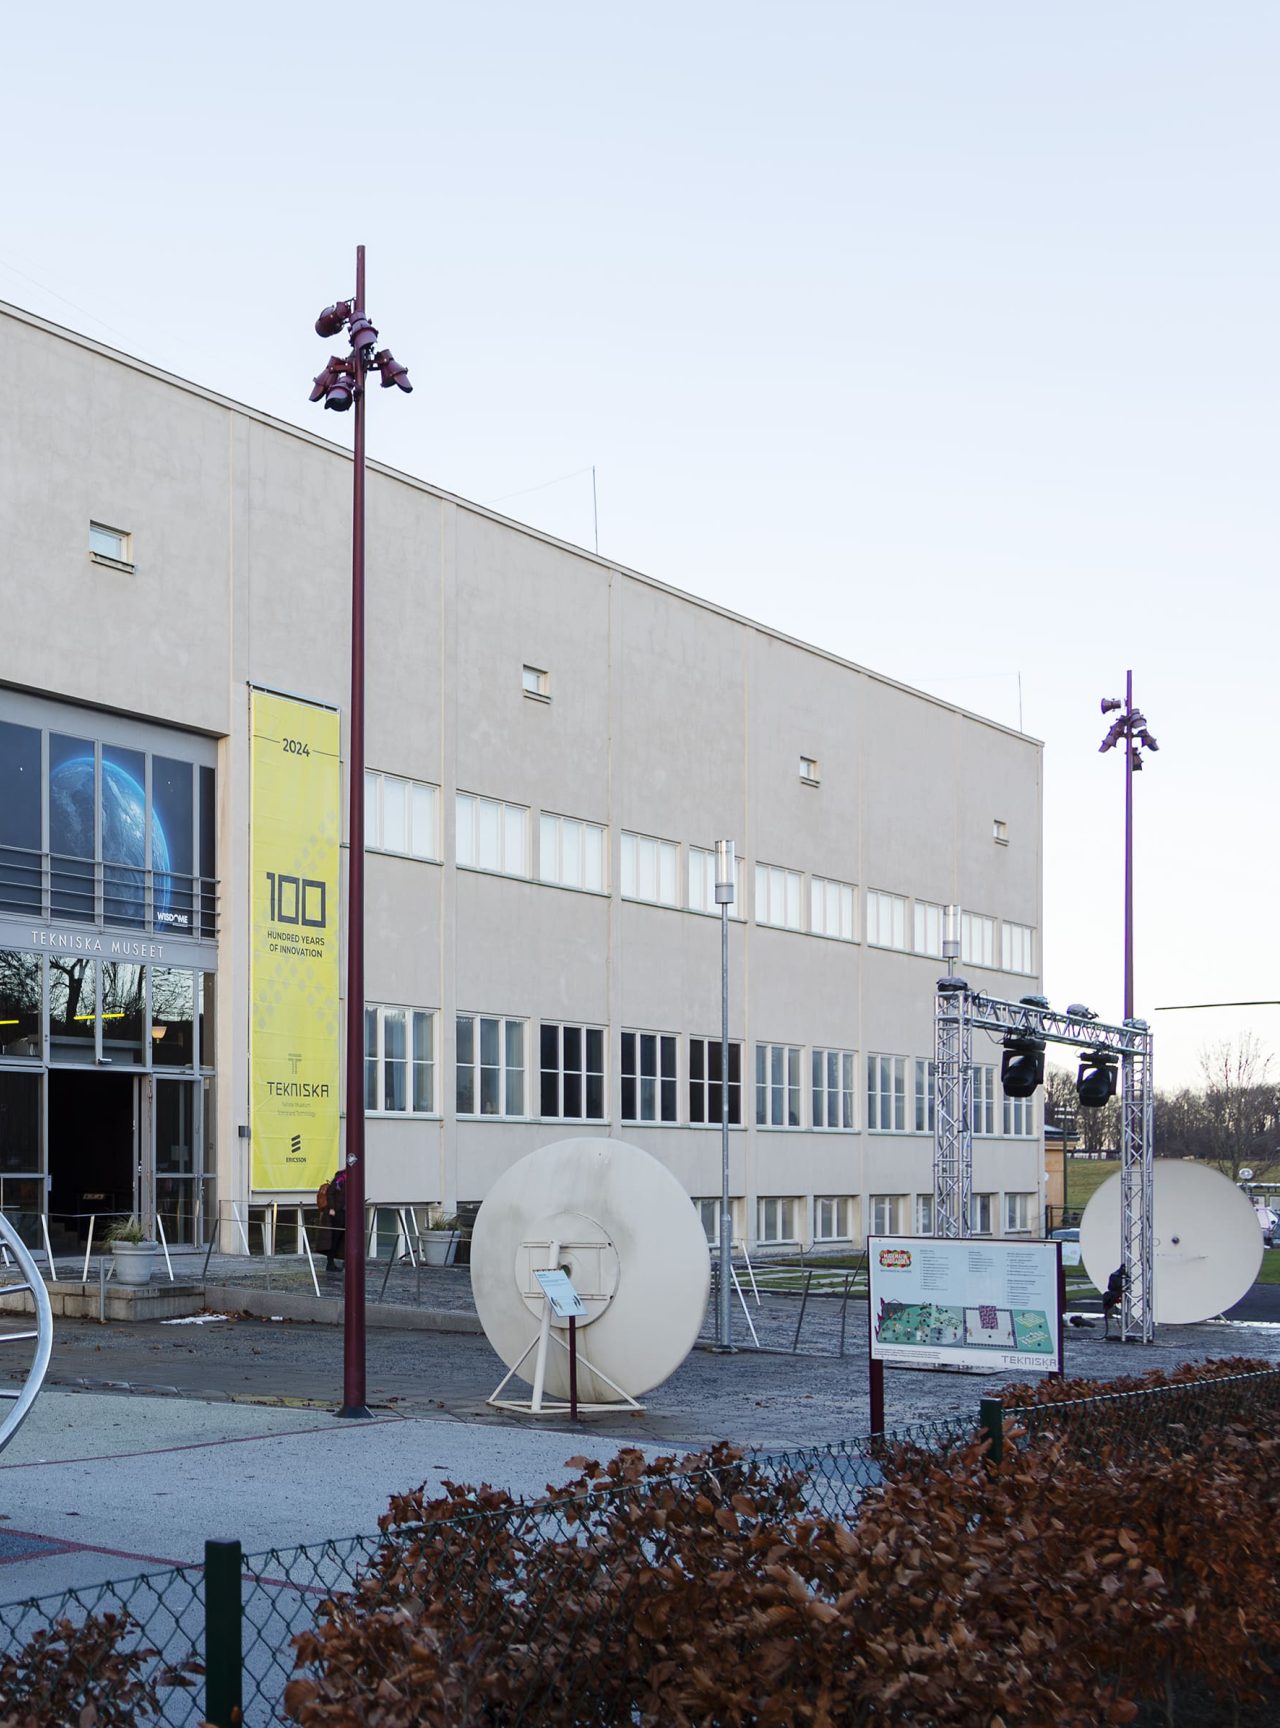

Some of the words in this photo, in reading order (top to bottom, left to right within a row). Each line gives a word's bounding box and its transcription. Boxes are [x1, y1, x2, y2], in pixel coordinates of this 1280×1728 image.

[282, 738, 310, 757] 2024
[266, 872, 326, 928] 100
[32, 931, 102, 951] TEKNISKA
[111, 941, 163, 958] MUSEET
[267, 930, 300, 943] HUNDRED
[301, 935, 325, 946] YEARS
[269, 943, 278, 952] OF
[280, 945, 323, 958] INNOVATION
[267, 1081, 329, 1098] TEKNISKA
[1001, 1355, 1056, 1367] TEKNISKA
